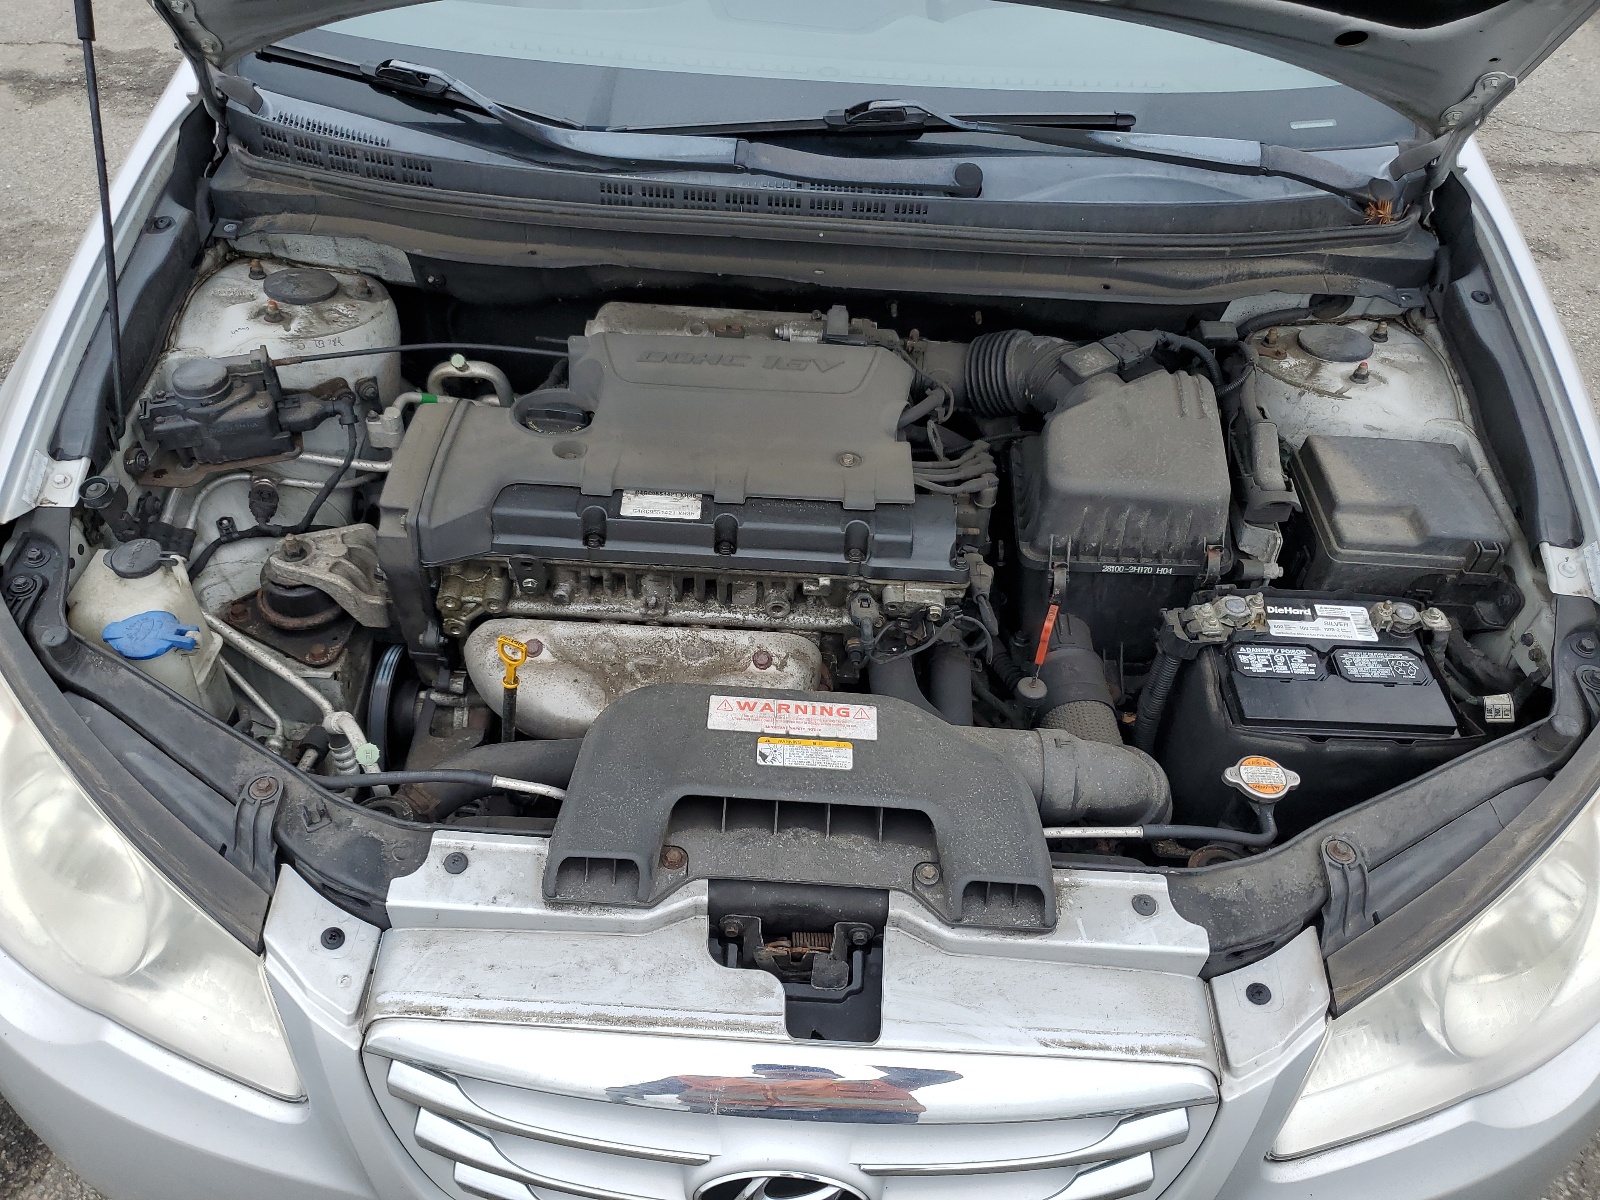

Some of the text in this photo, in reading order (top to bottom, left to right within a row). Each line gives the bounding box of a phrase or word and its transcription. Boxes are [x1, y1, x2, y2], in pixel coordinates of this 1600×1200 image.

[637, 351, 751, 368] DOHC
[1101, 564, 1173, 575] 28100-2H170 H04
[1266, 605, 1312, 616] DieHard
[1323, 620, 1349, 628] SILVER
[736, 700, 850, 718] WARNING
[364, 748, 373, 760] H
